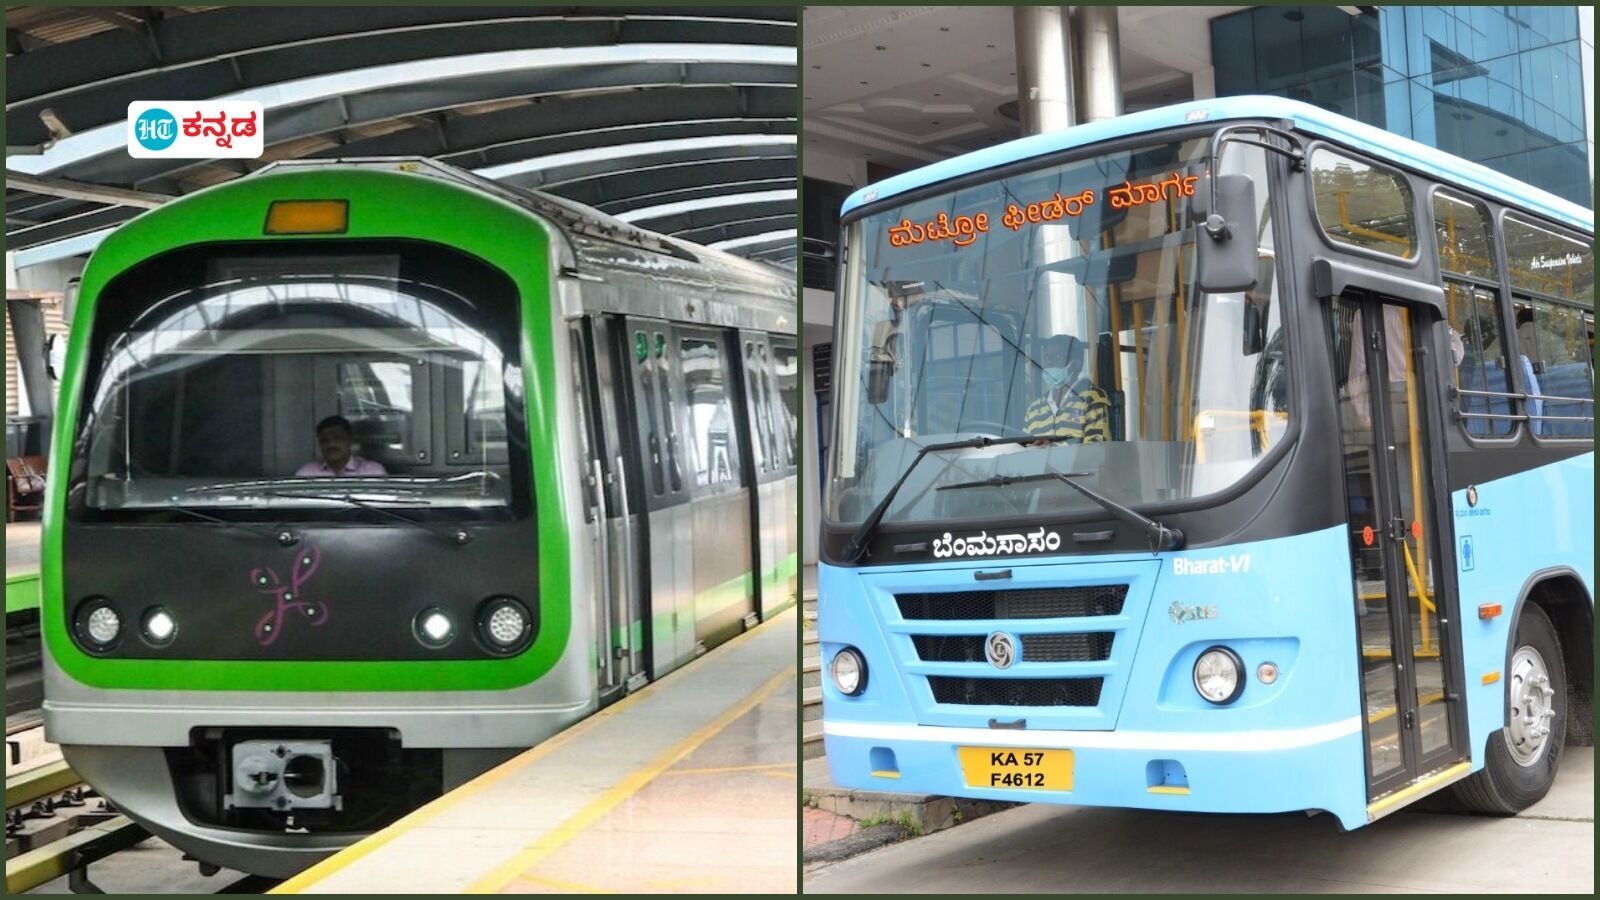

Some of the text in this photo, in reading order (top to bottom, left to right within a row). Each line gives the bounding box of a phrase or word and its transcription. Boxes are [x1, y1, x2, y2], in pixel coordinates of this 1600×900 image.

[888, 172, 1199, 247] ಮೆಟ್ರೋ ಫೀಡರ್ ಮಾರ್ಗ
[933, 526, 1061, 558] ಬೆಂಮಸಾಸಂ
[1172, 554, 1252, 576] Bharat-VI
[991, 752, 1045, 767] KA 57
[990, 772, 1046, 787] F4612
